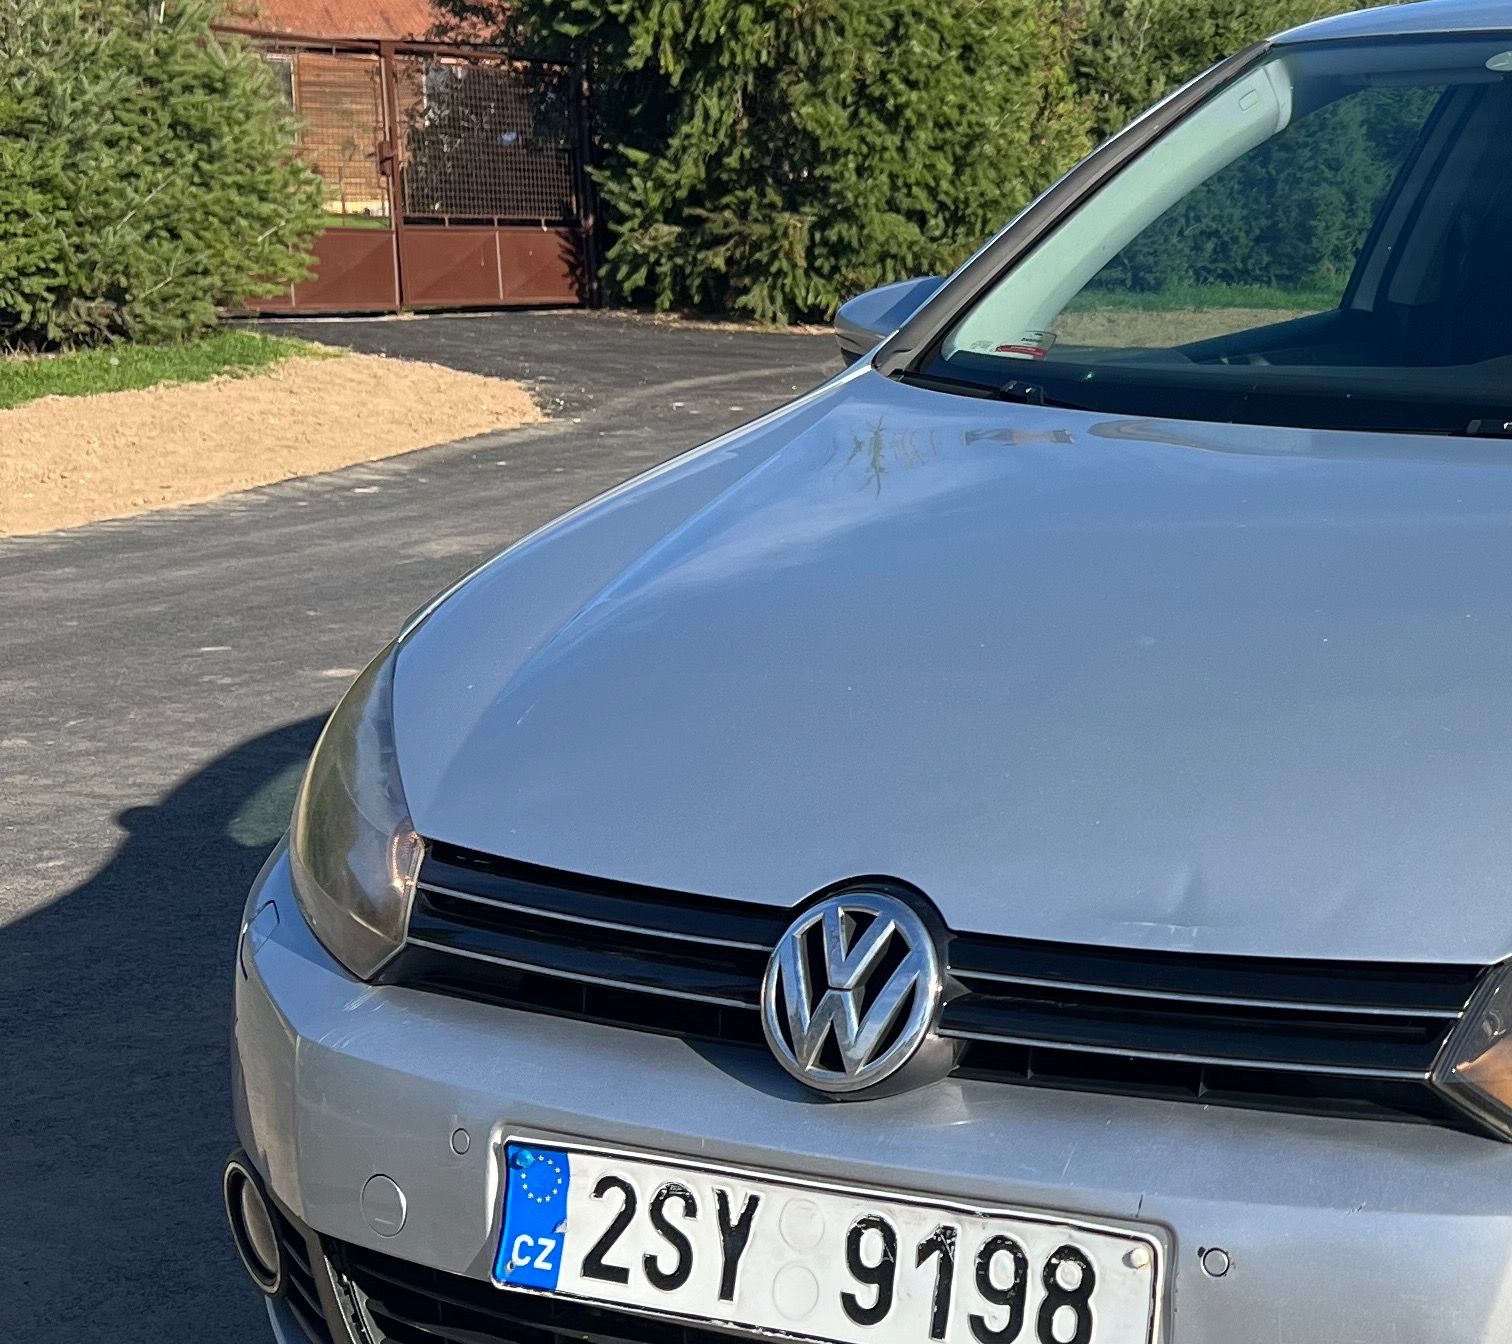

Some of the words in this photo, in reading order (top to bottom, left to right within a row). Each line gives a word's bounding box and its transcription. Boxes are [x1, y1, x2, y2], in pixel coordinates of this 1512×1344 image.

[770, 899, 932, 1084] VW
[511, 1233, 557, 1271] CZ
[581, 1175, 758, 1302] 2SY
